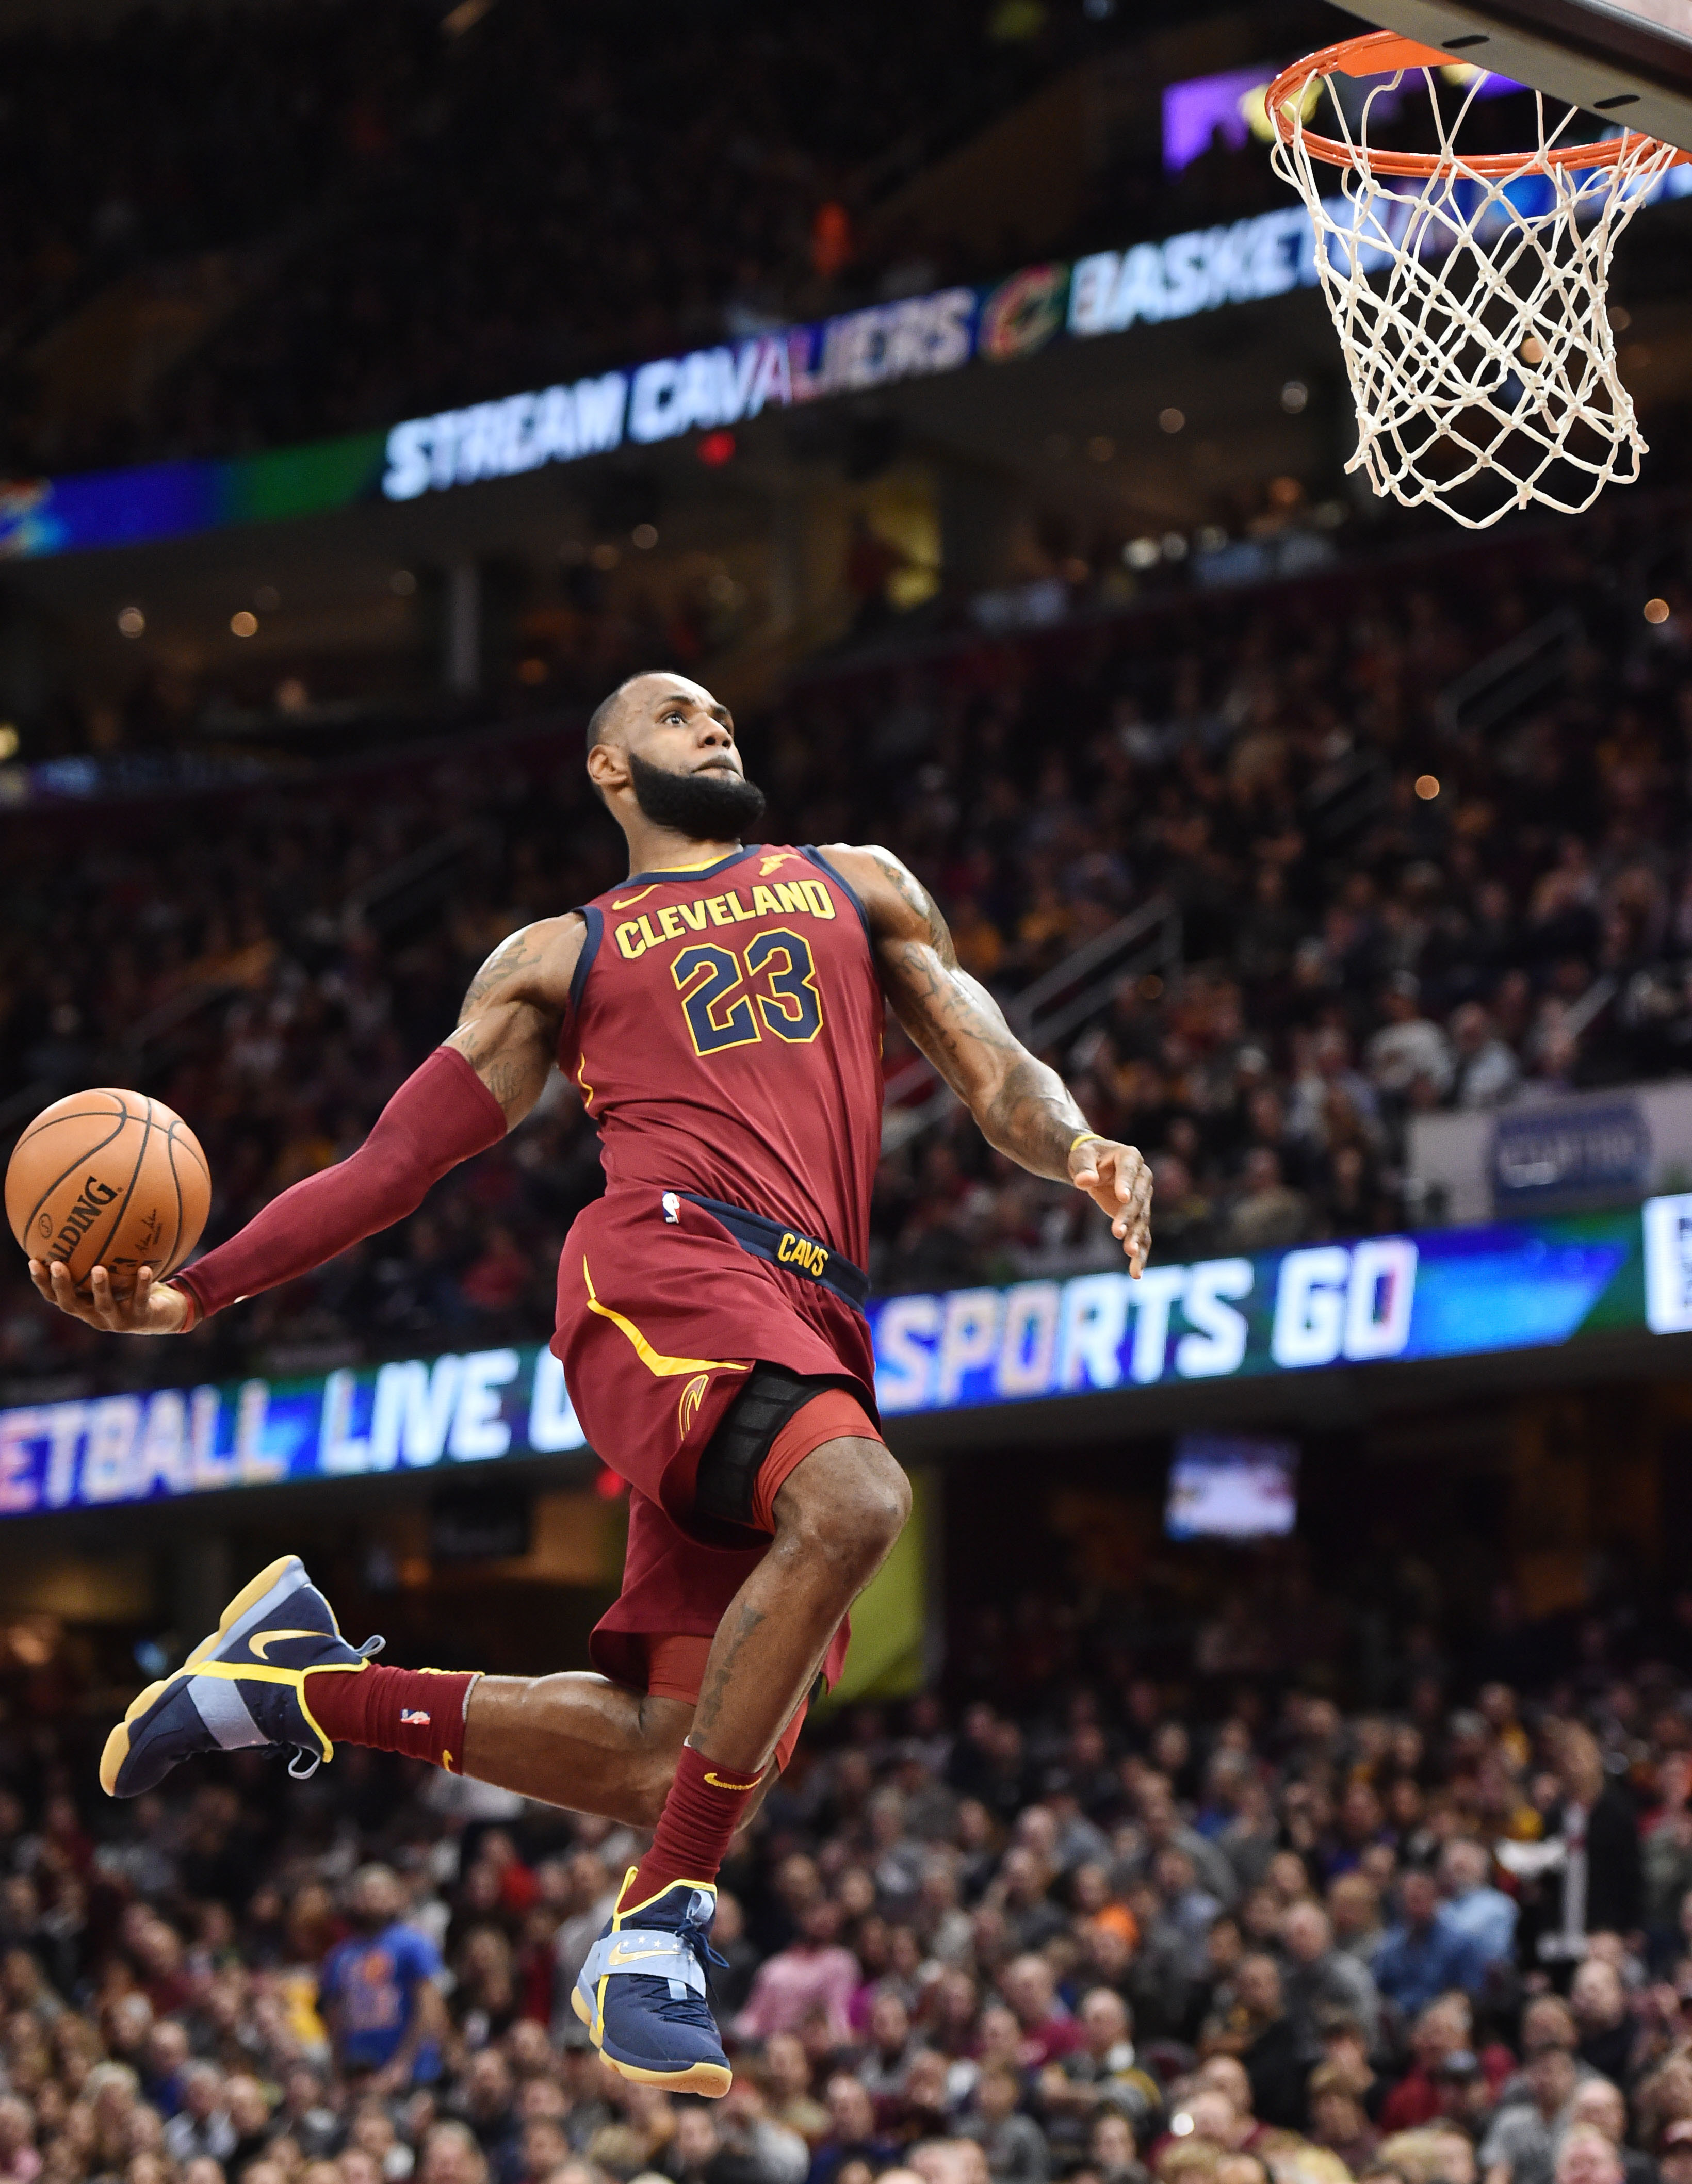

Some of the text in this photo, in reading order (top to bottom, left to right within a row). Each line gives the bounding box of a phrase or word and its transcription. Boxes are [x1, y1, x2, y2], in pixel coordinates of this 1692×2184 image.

[381, 370, 628, 501] STREAM
[627, 286, 976, 444] CAVALIERS
[614, 879, 837, 959] CLEVELAND
[670, 927, 823, 1056] 23
[778, 1233, 828, 1277] CAVS
[318, 1347, 520, 1475] LIVE
[875, 1257, 1254, 1410] SPORTS
[1271, 1235, 1419, 1368] GO
